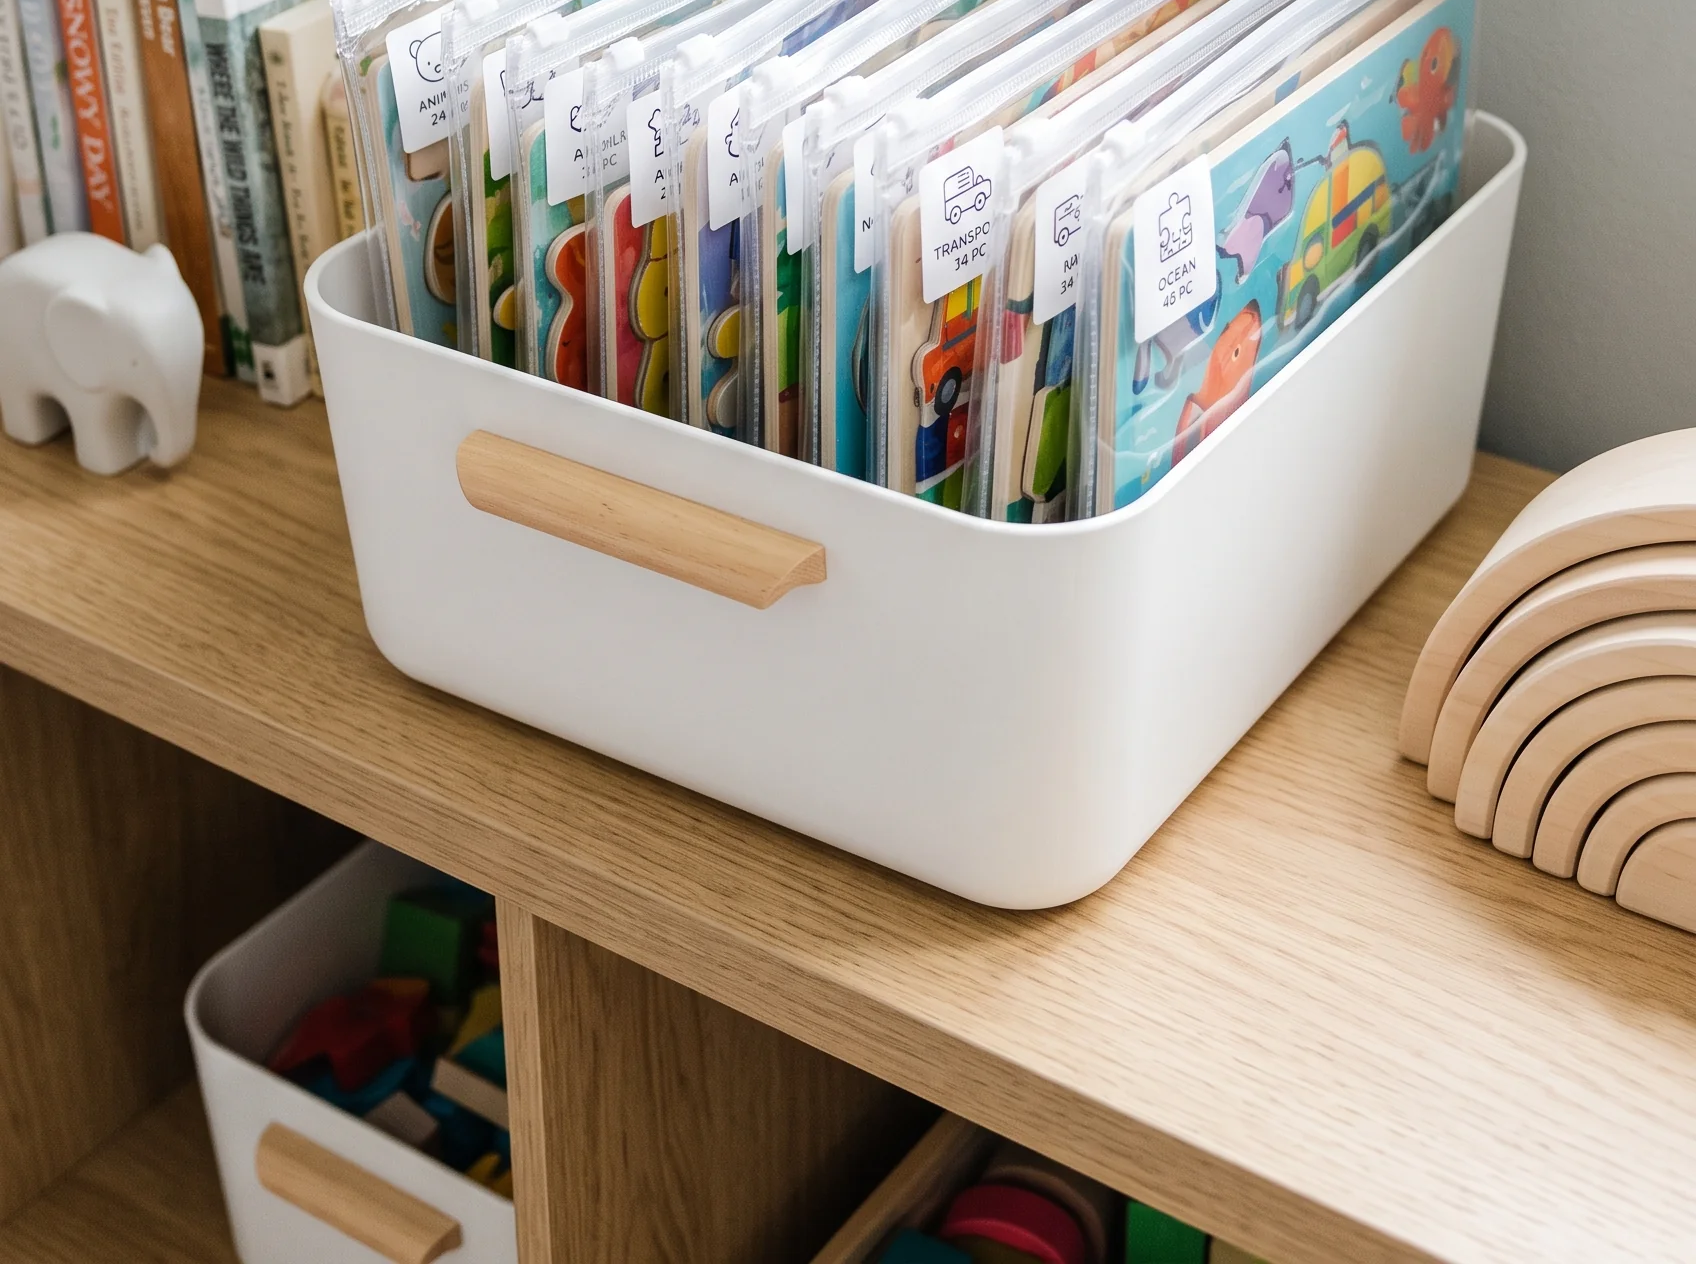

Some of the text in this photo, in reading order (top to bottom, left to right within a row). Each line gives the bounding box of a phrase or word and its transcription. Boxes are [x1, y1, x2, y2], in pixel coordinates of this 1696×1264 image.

[206, 43, 235, 102] WHERE
[217, 105, 240, 135] THE
[431, 109, 447, 127] 24
[82, 133, 109, 207] DAY
[223, 139, 248, 182] WILD
[231, 187, 259, 246] THINGS
[955, 242, 987, 272] 34 PC
[1060, 276, 1074, 295] 34
[1158, 256, 1197, 292] OCEAN
[1178, 280, 1194, 301] PC
